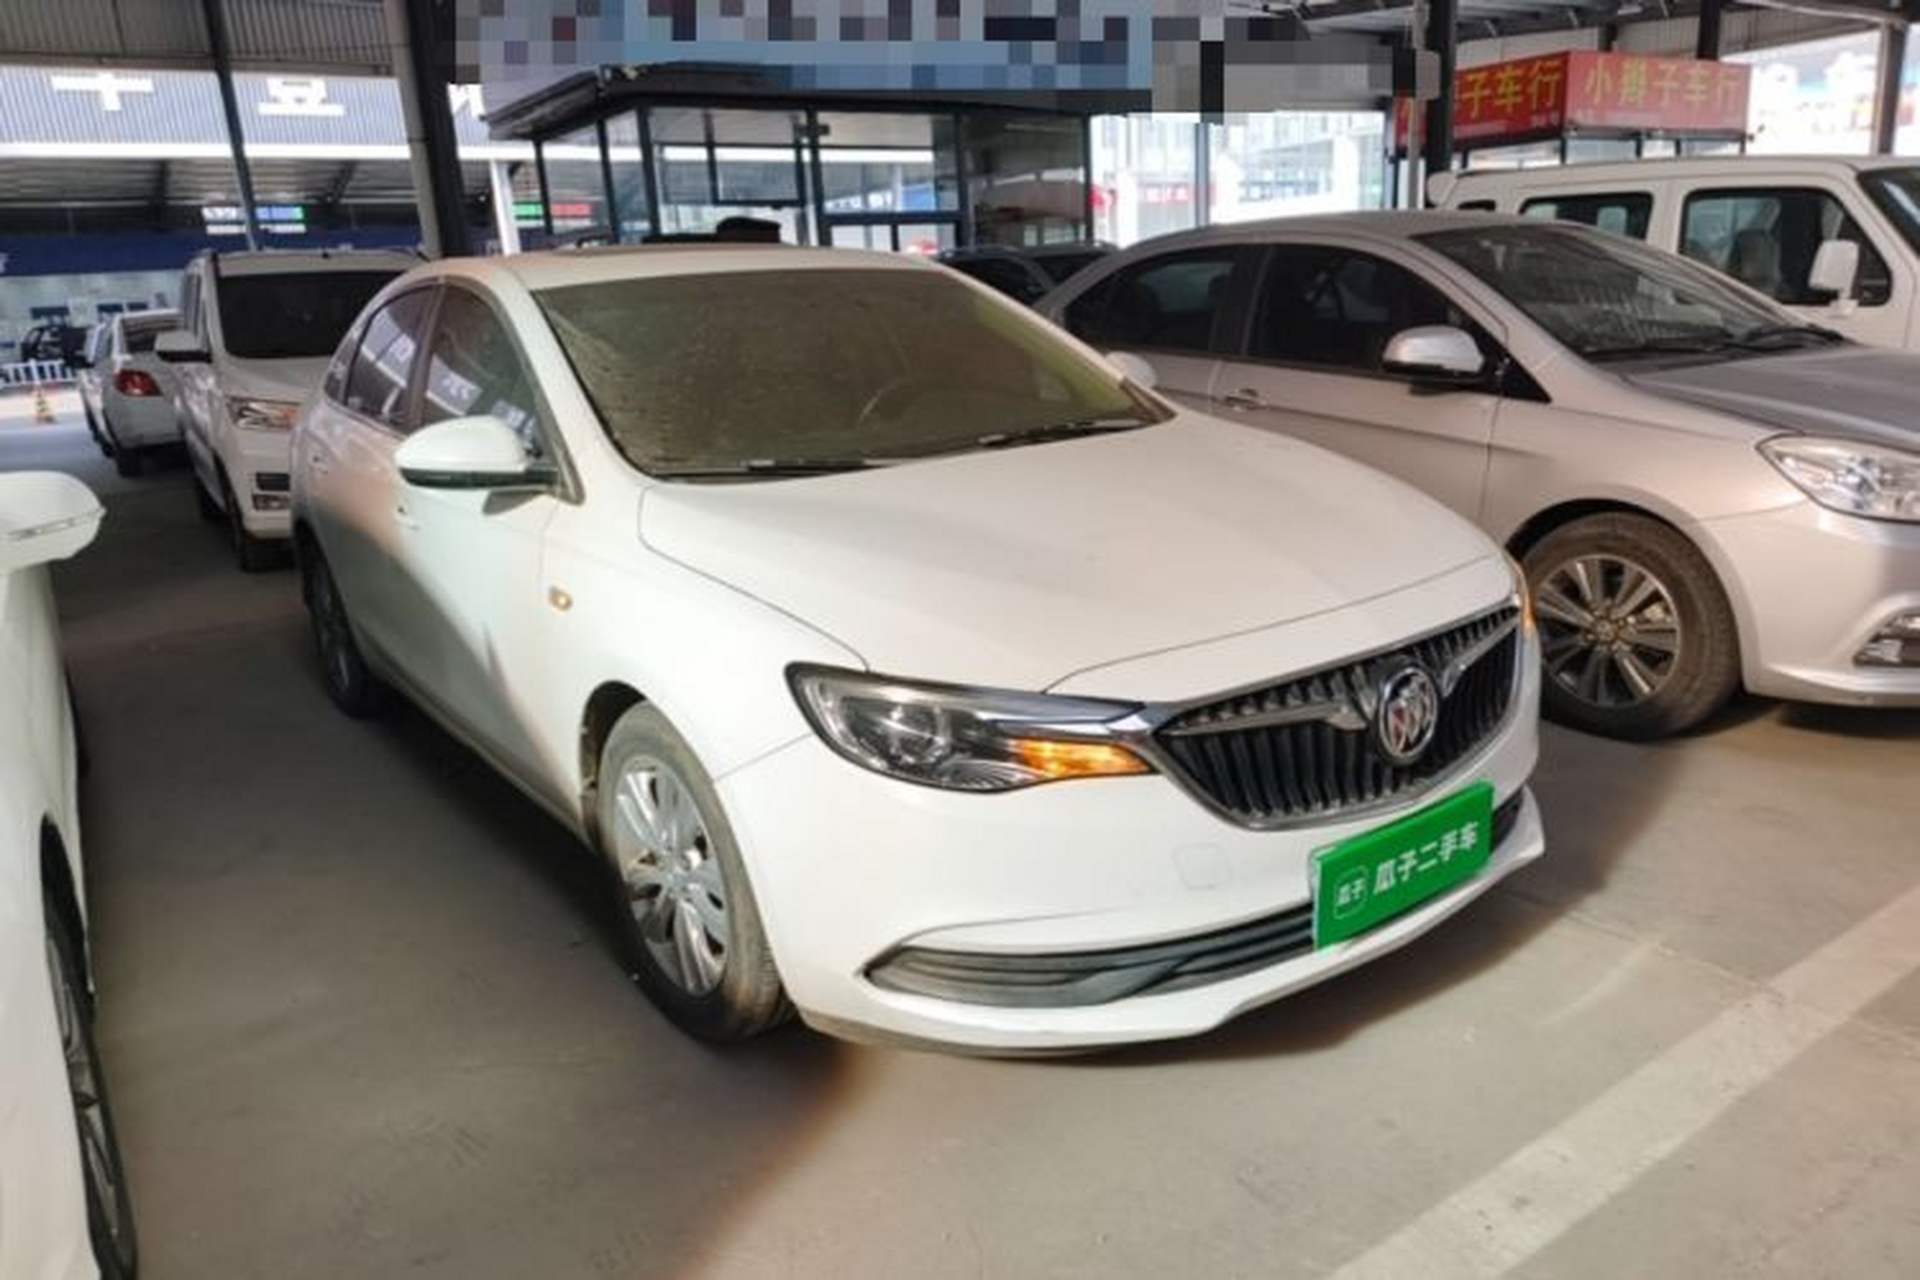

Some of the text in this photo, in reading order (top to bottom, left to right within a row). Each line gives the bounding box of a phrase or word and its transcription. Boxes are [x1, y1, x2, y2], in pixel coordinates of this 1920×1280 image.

[1455, 59, 1563, 120] 子车行
[1373, 821, 1479, 895] 瓜子二手车
